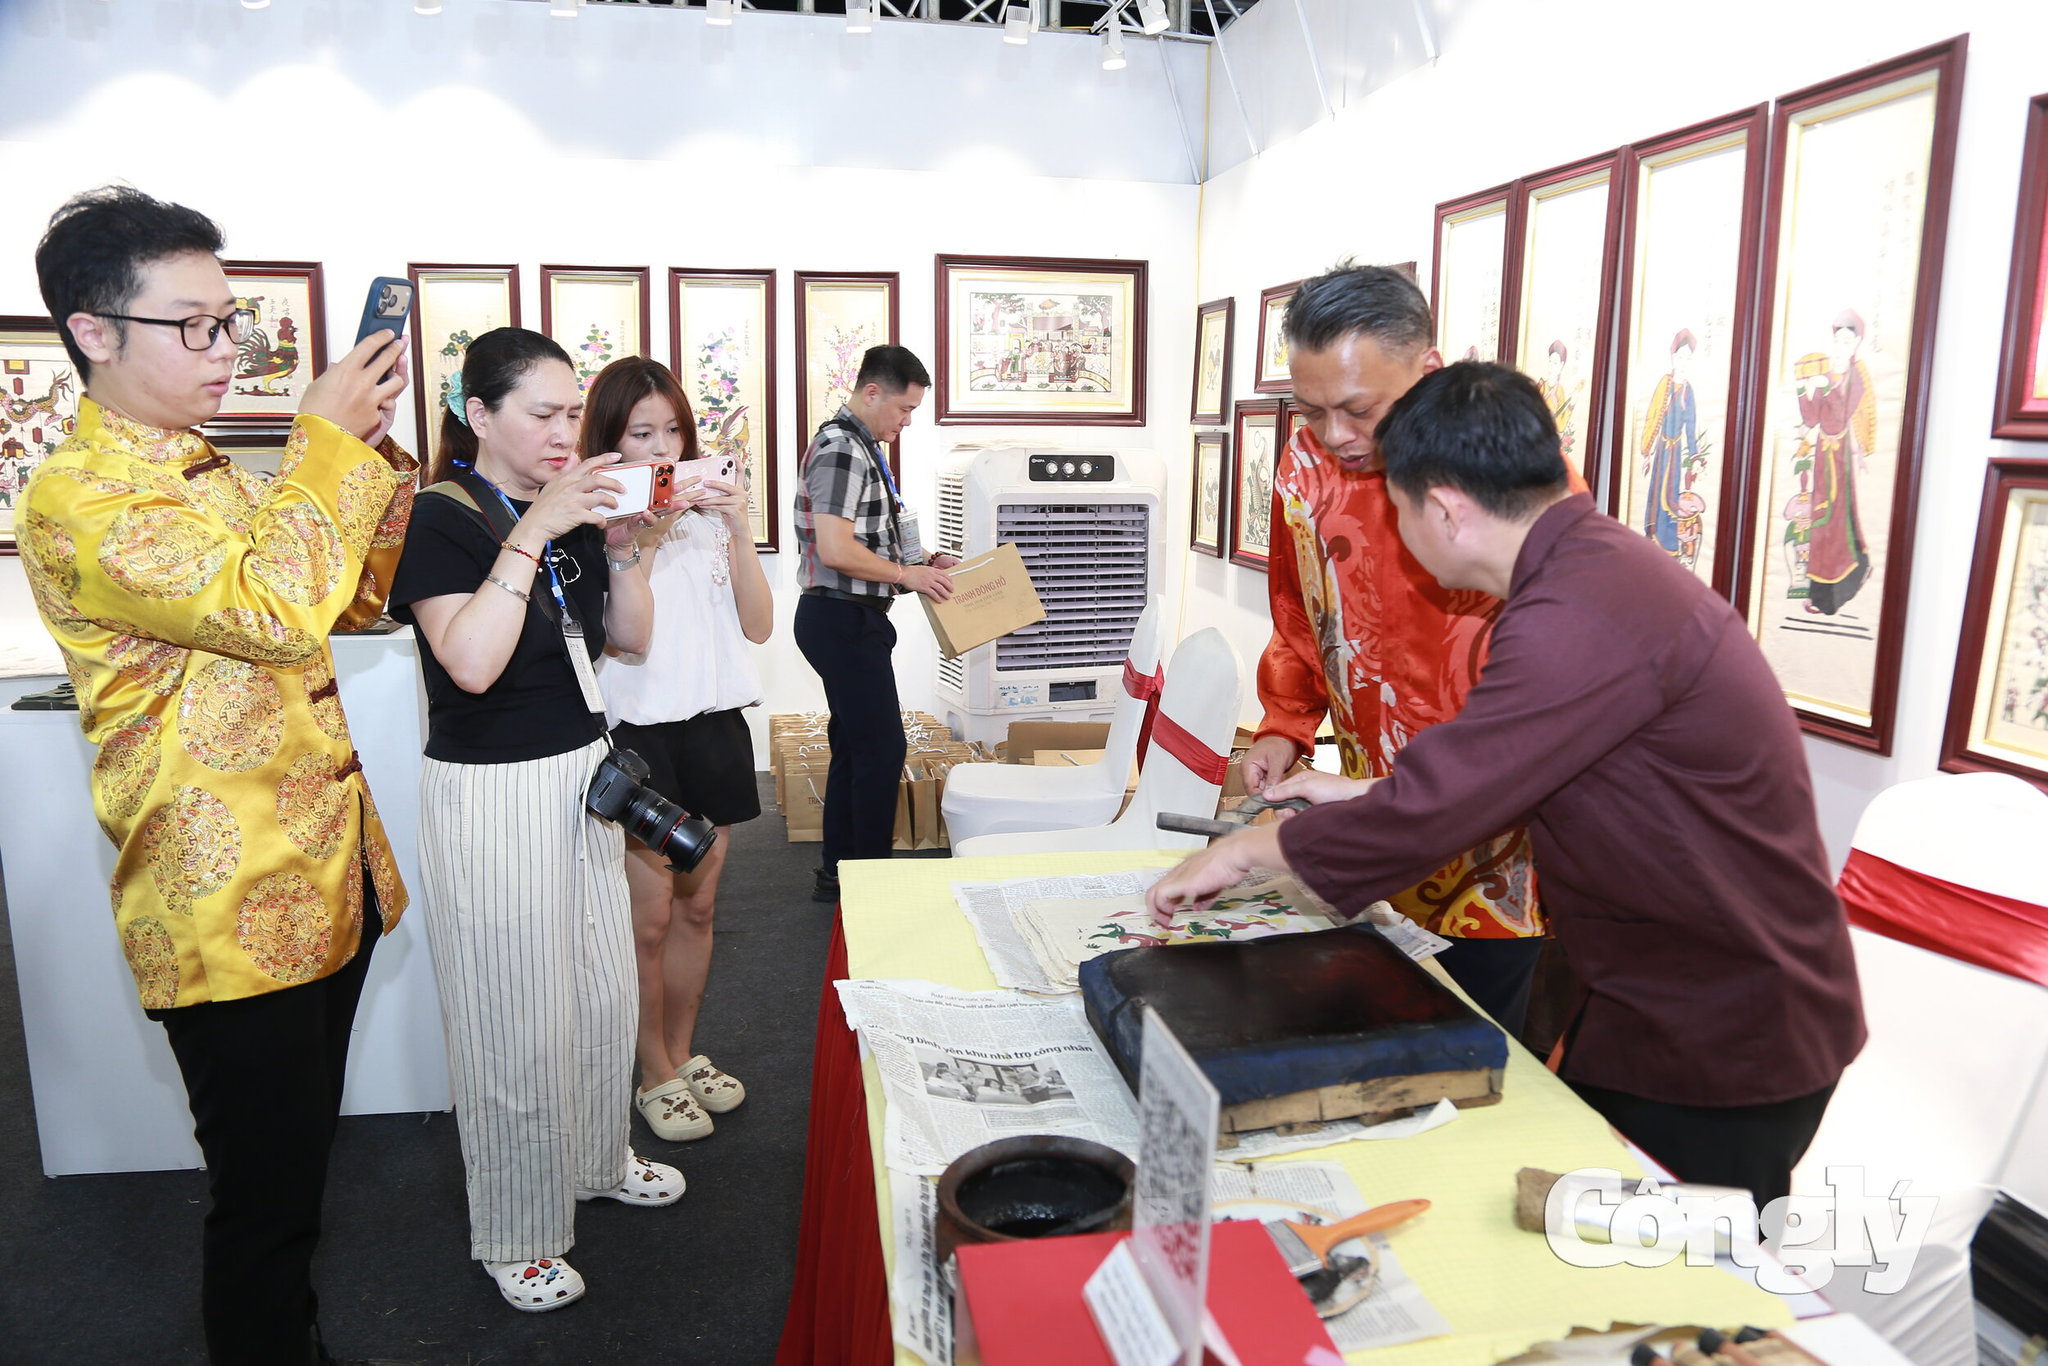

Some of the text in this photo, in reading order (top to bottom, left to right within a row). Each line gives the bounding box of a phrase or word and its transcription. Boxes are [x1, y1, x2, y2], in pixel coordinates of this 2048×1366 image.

[965, 1049, 987, 1058] khu
[990, 1051, 1012, 1059] nhà
[1014, 1050, 1031, 1060] trọ
[1034, 1045, 1062, 1057] công
[1063, 1044, 1093, 1052] nhân
